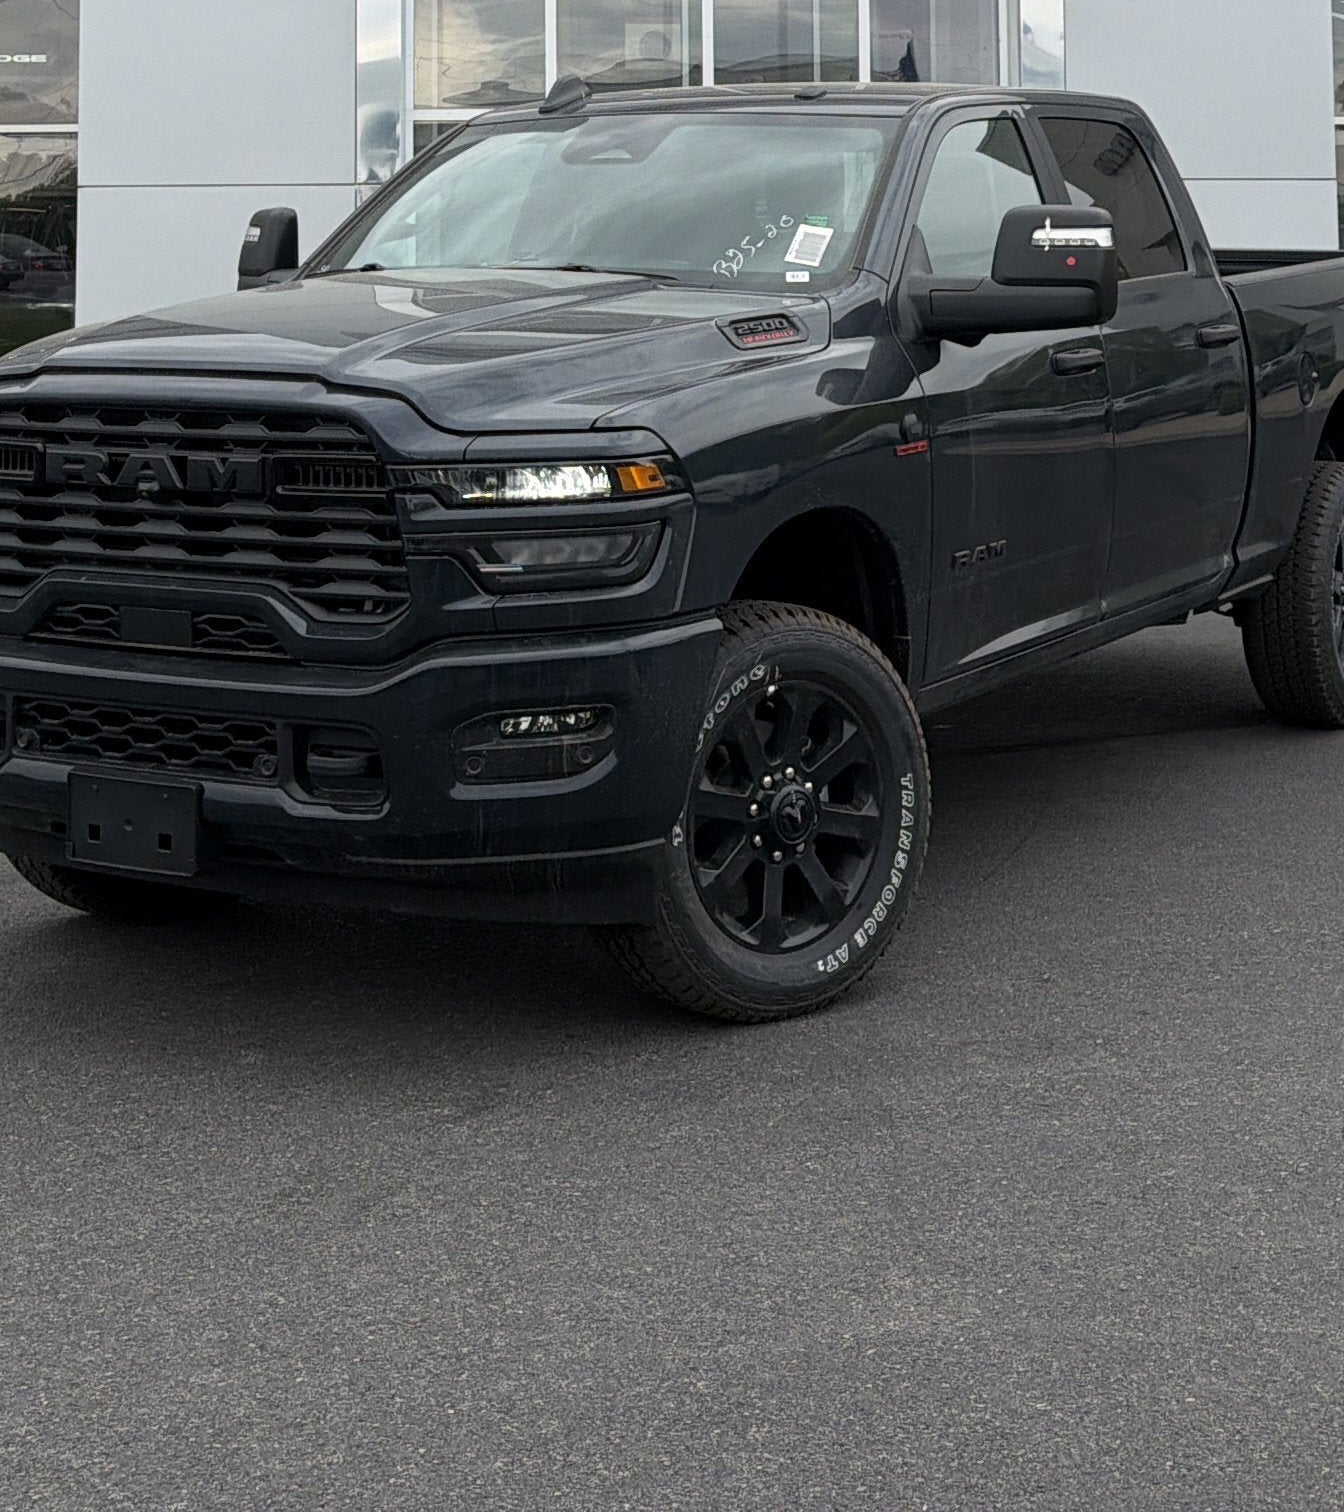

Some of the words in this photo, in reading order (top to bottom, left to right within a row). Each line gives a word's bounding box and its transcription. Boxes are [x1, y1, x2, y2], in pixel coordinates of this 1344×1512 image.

[735, 317, 788, 335] 2500
[46, 449, 262, 492] RAM
[953, 539, 1007, 569] RAM
[855, 773, 915, 948] TRANSFORCE
